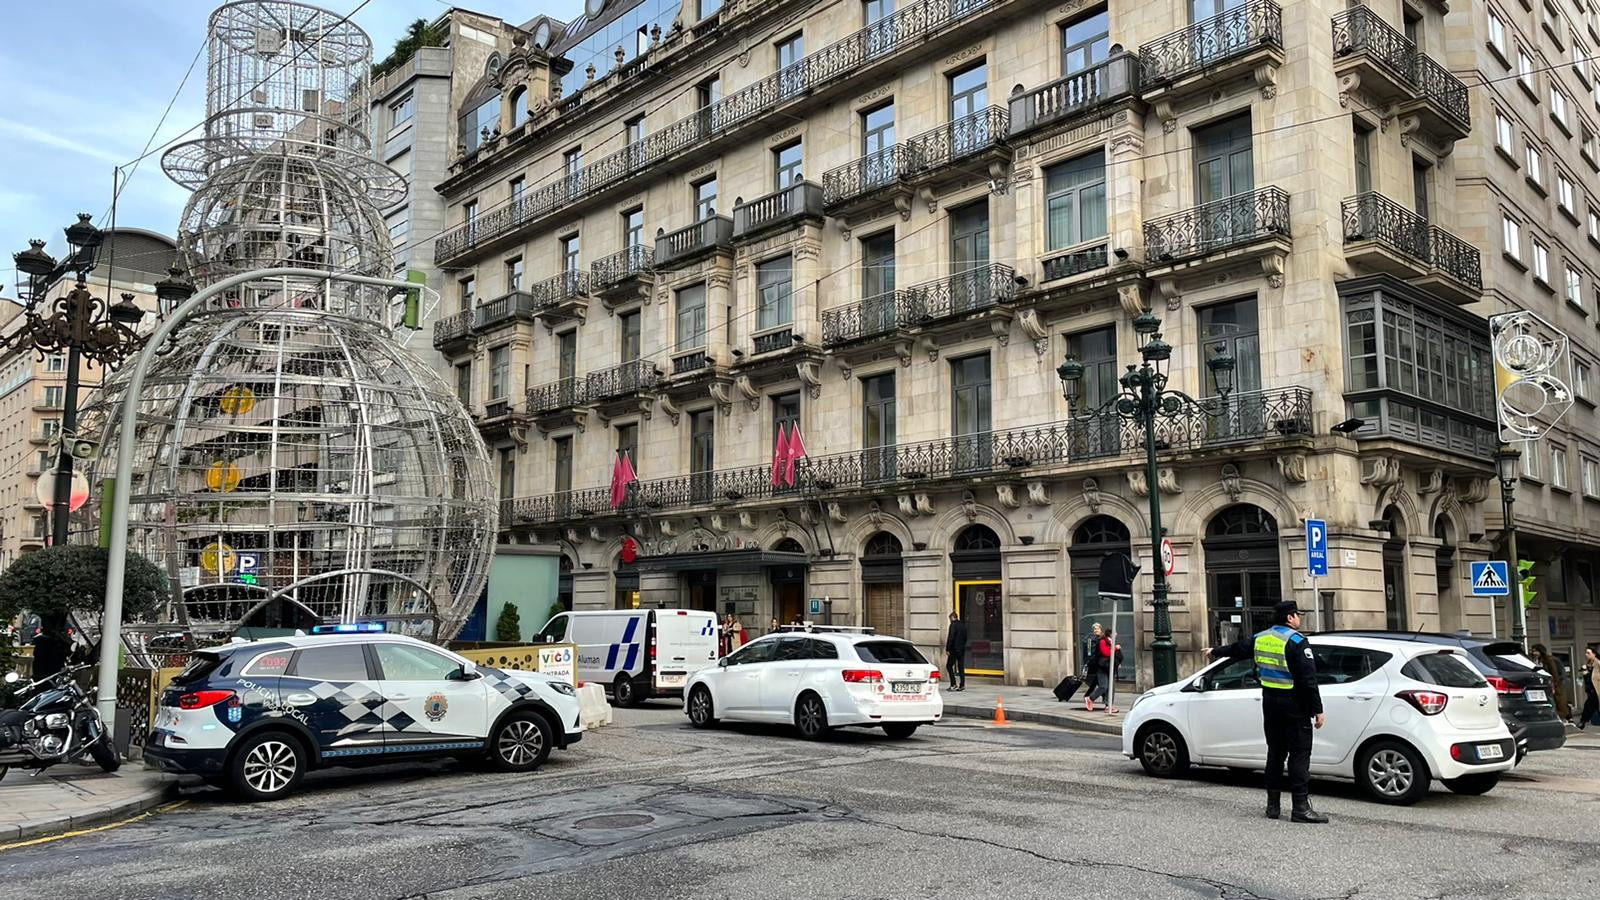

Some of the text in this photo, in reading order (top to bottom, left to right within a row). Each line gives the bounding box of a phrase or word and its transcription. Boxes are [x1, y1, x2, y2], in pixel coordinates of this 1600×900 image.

[1311, 527, 1322, 549] P
[239, 556, 256, 574] P
[1310, 551, 1325, 559] AREAL
[280, 701, 309, 726] LOCAL
